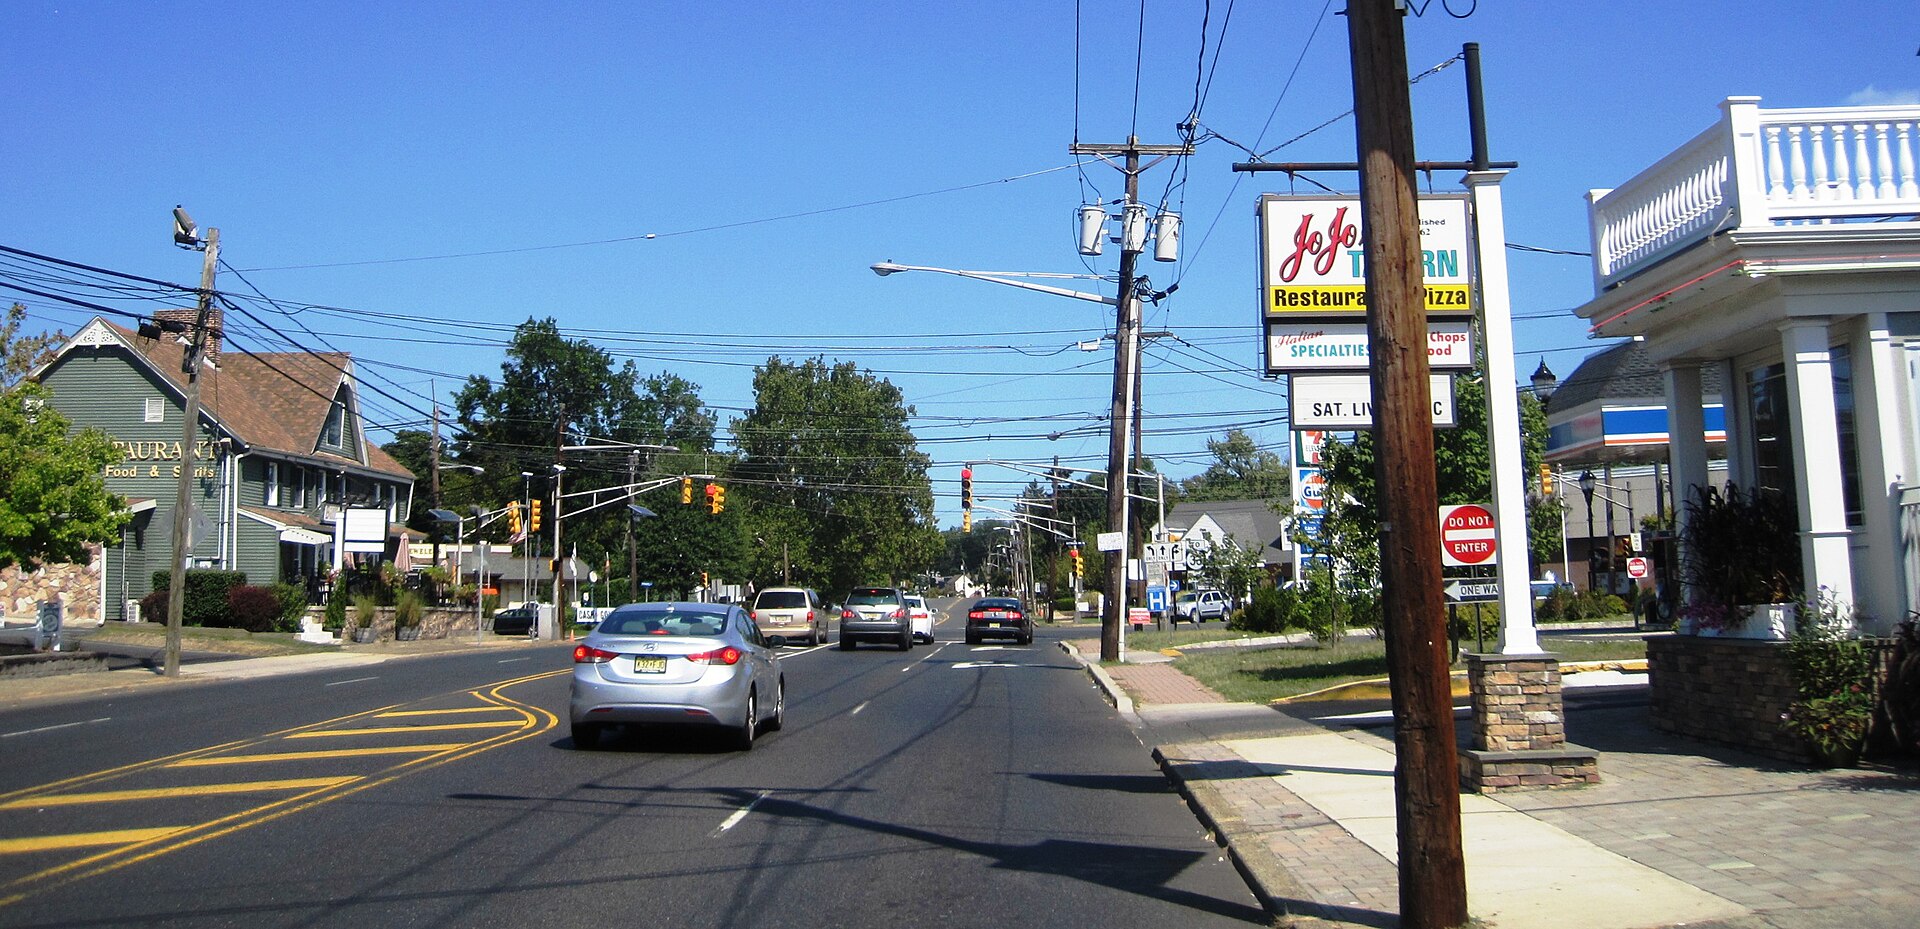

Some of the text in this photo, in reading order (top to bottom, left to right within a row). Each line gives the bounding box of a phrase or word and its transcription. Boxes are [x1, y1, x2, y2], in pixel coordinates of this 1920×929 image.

[1418, 218, 1446, 226] lished
[1419, 228, 1431, 236] 62
[1279, 206, 1362, 283] JoJo
[1347, 249, 1459, 278] TRN
[1275, 289, 1367, 307] Restaura
[1274, 328, 1325, 349] Italian
[1430, 331, 1466, 344] Chops
[1313, 402, 1373, 417] SAT. LIV
[105, 464, 214, 479] Food & Srits
[1304, 486, 1322, 498] Gu
[1449, 515, 1489, 527] DO NOT
[1454, 542, 1488, 553] ENTER
[1460, 585, 1481, 596] ONE
[1149, 592, 1164, 610] H
